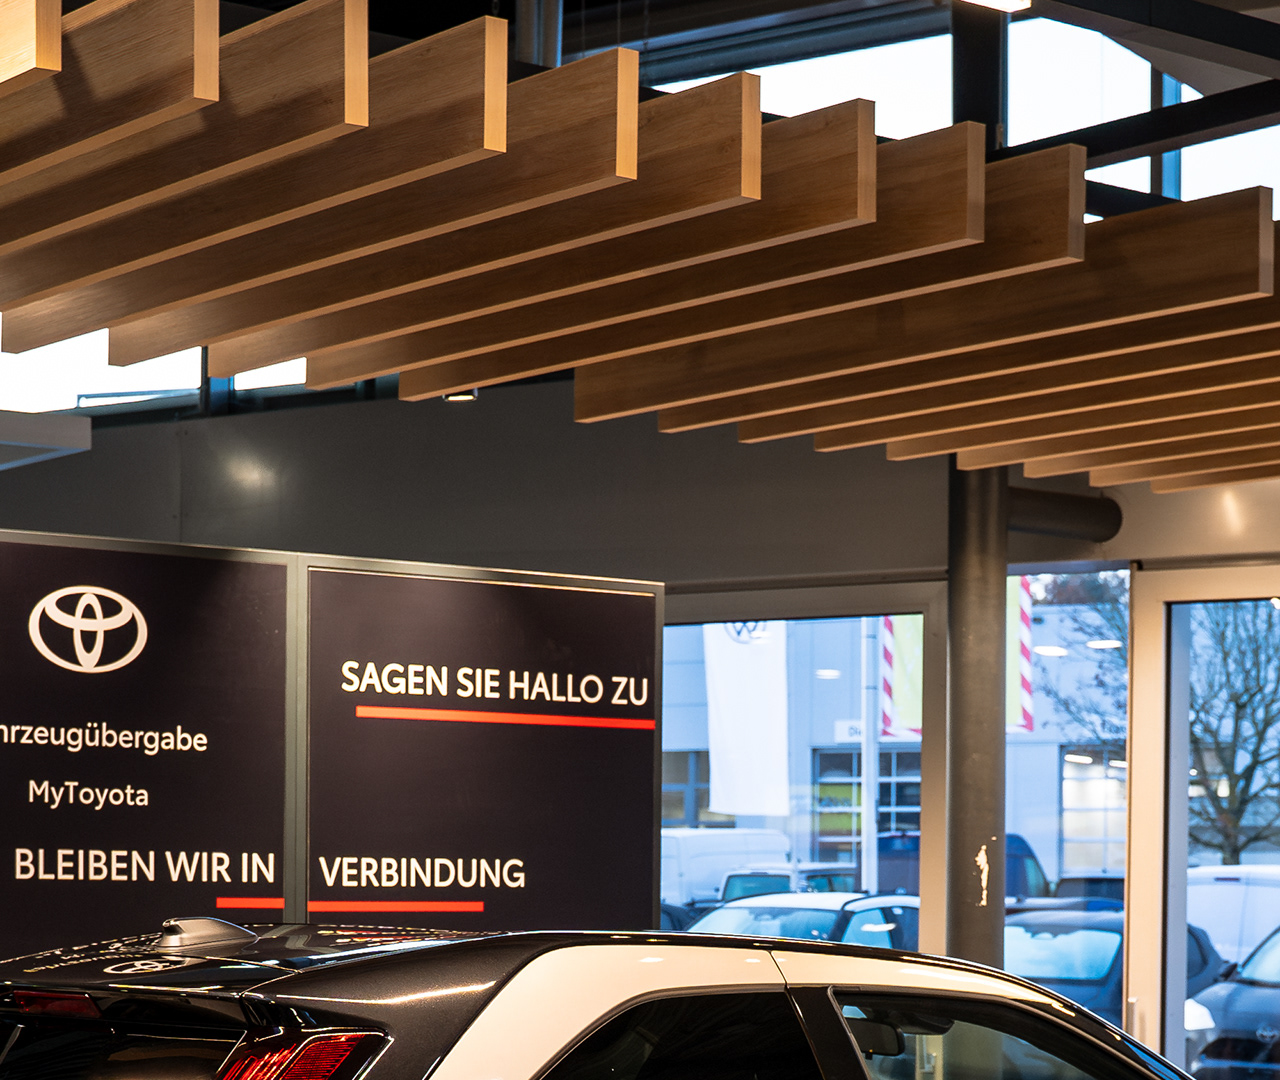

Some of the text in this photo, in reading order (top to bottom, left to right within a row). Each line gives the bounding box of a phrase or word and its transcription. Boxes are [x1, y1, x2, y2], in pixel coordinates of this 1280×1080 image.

[341, 660, 648, 706] SAGEN SIE HALLO ZU
[28, 779, 149, 811] MyToyota
[15, 848, 526, 888] BLEIBEN WIR IN VERBINDUNG
